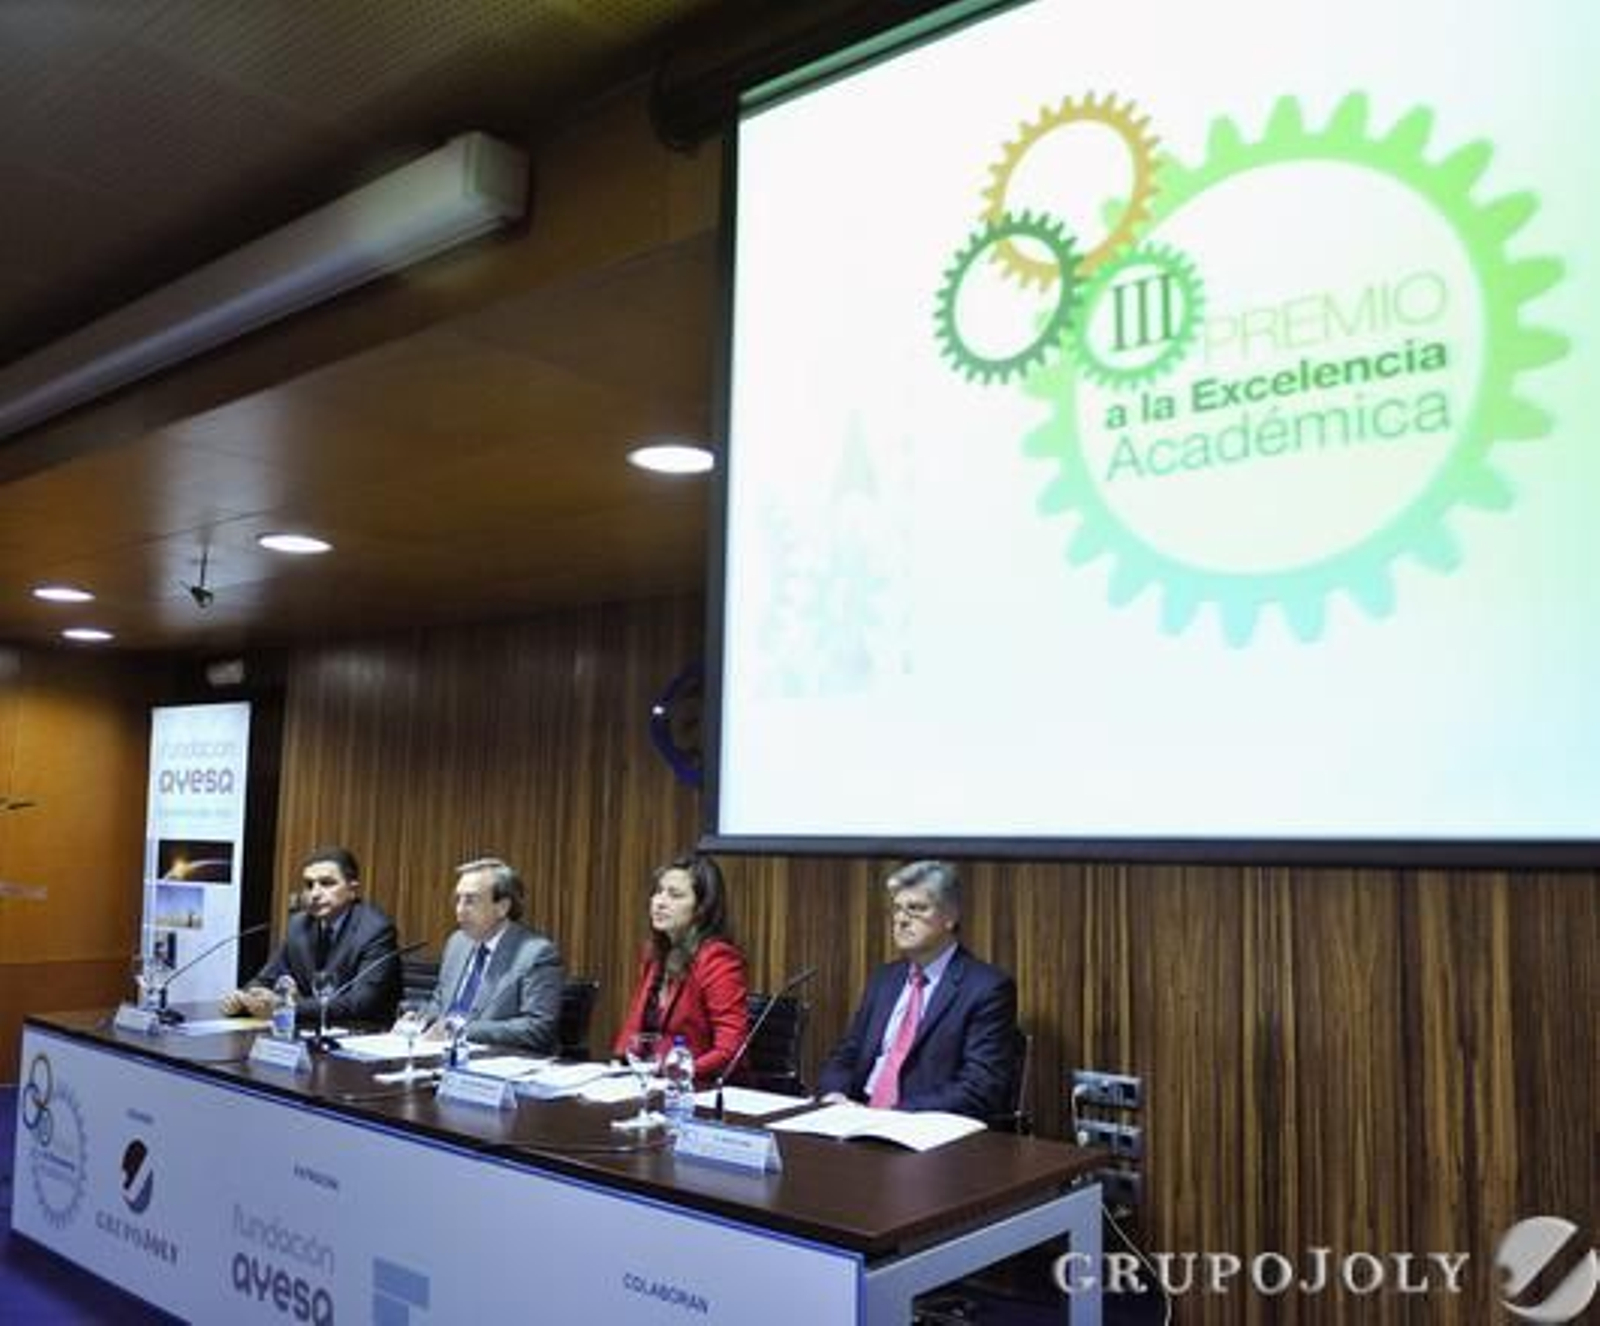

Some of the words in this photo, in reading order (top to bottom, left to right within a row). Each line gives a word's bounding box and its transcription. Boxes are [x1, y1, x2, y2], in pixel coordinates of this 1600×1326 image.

[1112, 273, 1176, 352] III
[1204, 271, 1448, 361] PREMIO
[1106, 403, 1128, 430] a
[1140, 391, 1176, 424] la
[1190, 338, 1447, 414] Excelencia
[1106, 389, 1451, 481] Académica
[623, 1272, 709, 1315] COLABORAN
